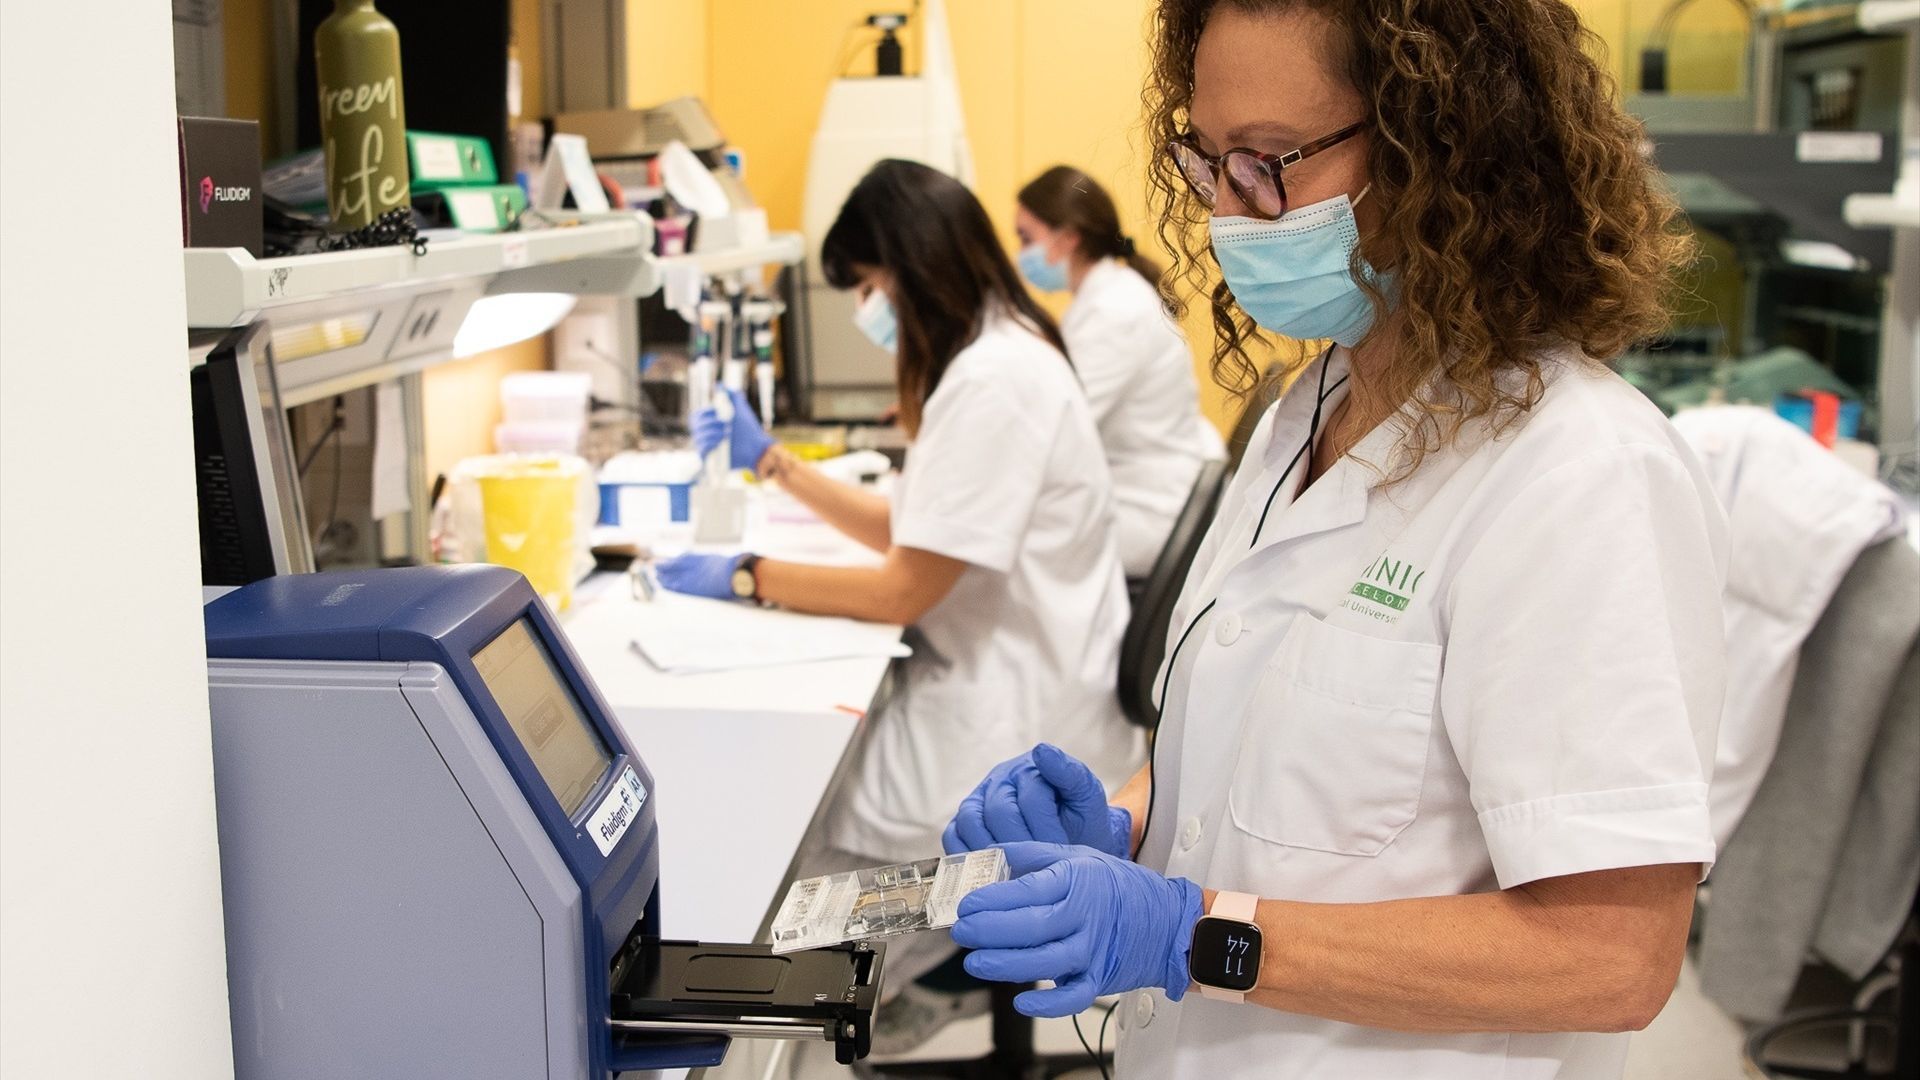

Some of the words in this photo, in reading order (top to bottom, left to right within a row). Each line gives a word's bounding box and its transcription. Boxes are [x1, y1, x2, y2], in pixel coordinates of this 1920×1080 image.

[319, 76, 397, 120] reen
[214, 186, 251, 202] FLUIDIGM
[326, 124, 410, 225] life
[600, 805, 629, 842] Fluidigm
